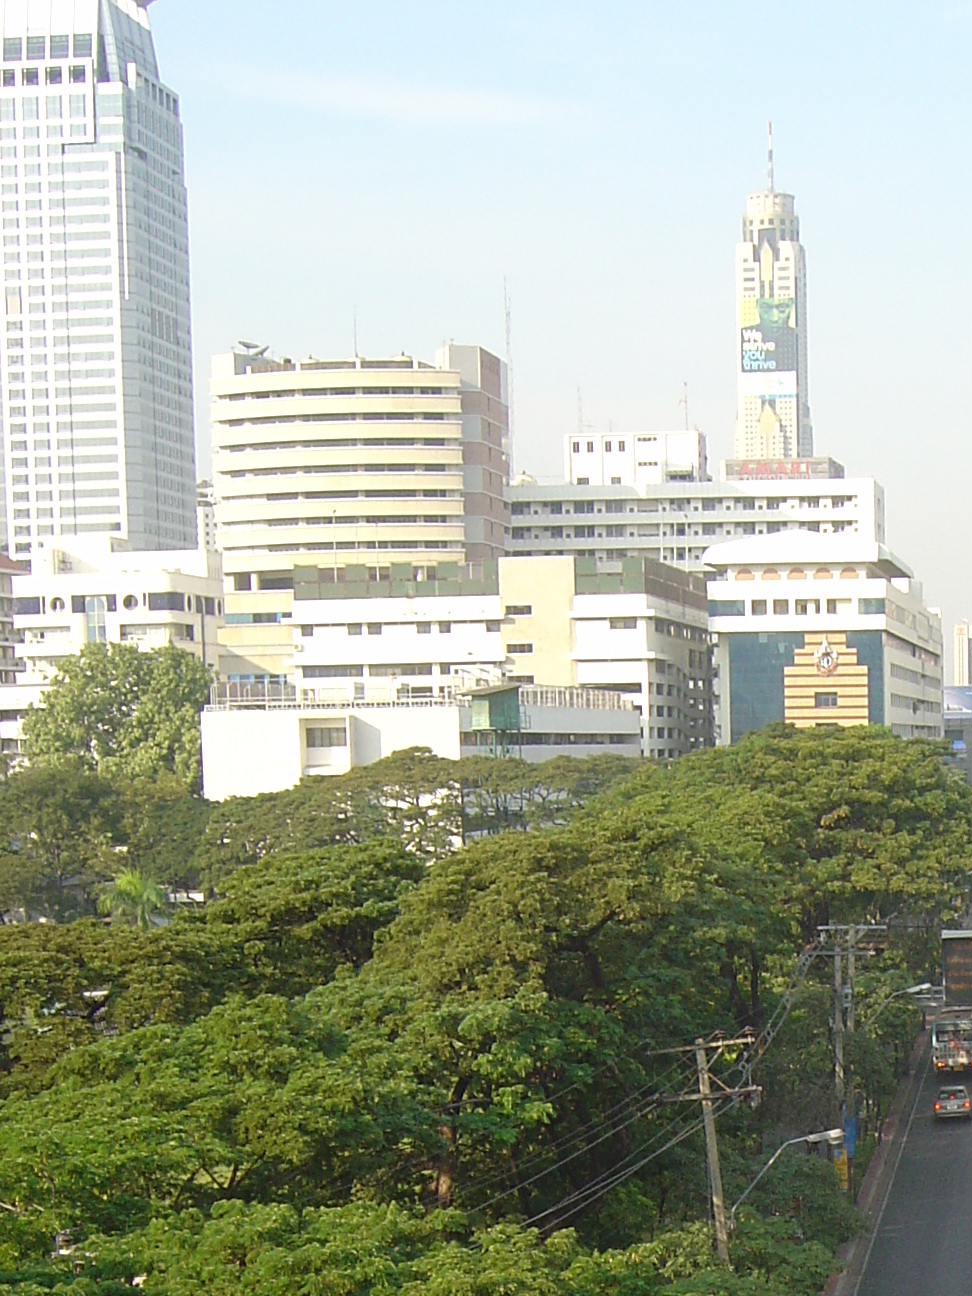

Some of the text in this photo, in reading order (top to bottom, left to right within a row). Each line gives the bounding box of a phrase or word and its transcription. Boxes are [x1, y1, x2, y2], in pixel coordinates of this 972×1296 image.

[742, 329, 762, 342] We
[742, 340, 776, 351] strive
[742, 350, 765, 361] you
[743, 359, 776, 370] thrive
[739, 460, 811, 475] AMARI
